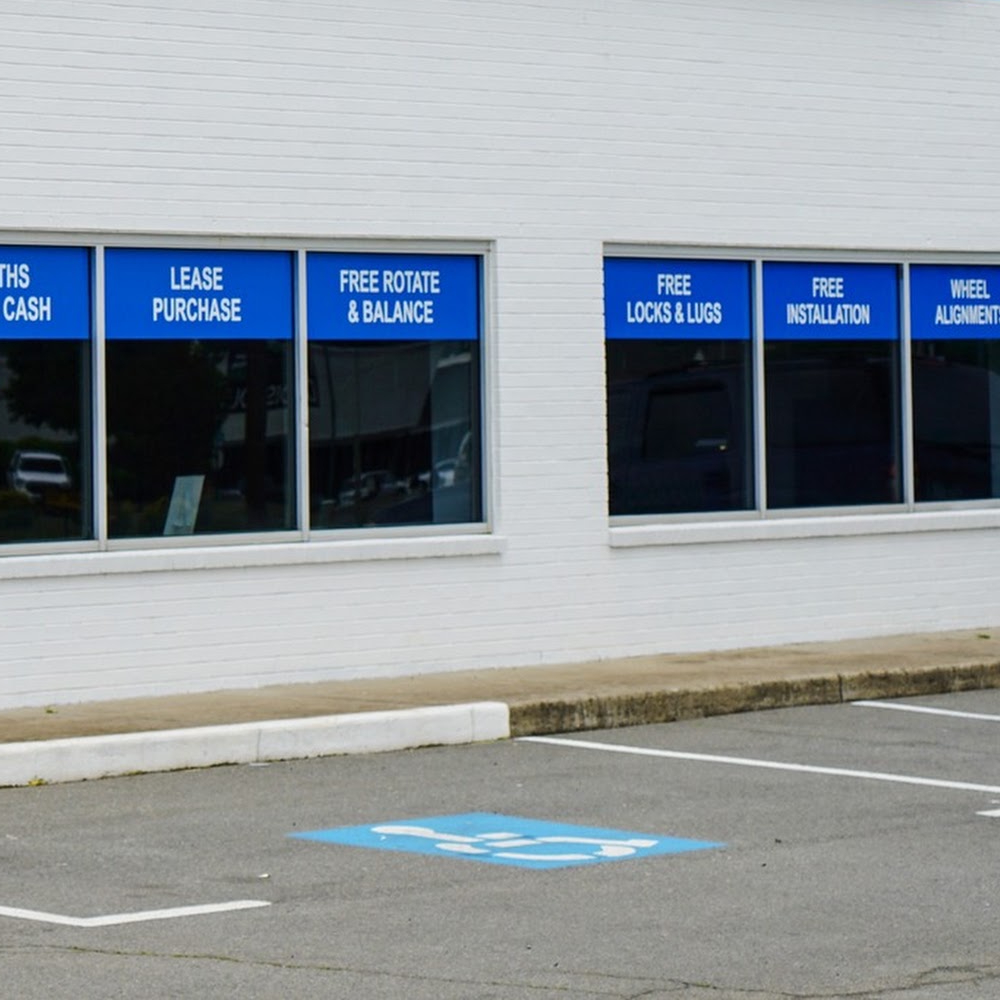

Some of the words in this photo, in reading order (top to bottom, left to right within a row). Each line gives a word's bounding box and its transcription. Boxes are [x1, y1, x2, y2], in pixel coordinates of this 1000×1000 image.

[170, 266, 224, 291] LEASE
[339, 269, 380, 293] FREE
[382, 270, 441, 294] ROTATE
[657, 273, 692, 296] FREE
[812, 277, 844, 298] FREE
[950, 279, 991, 299] WHEEL
[2, 296, 52, 322] CASH
[152, 297, 242, 322] PURCHASE
[347, 299, 360, 324] &
[362, 300, 434, 324] BALANCE
[626, 301, 672, 324] LOCKS
[674, 302, 685, 324] &
[686, 302, 722, 324] LUGS
[786, 304, 870, 325] INSTALLATION
[934, 304, 1000, 325] ALIGNMENT
